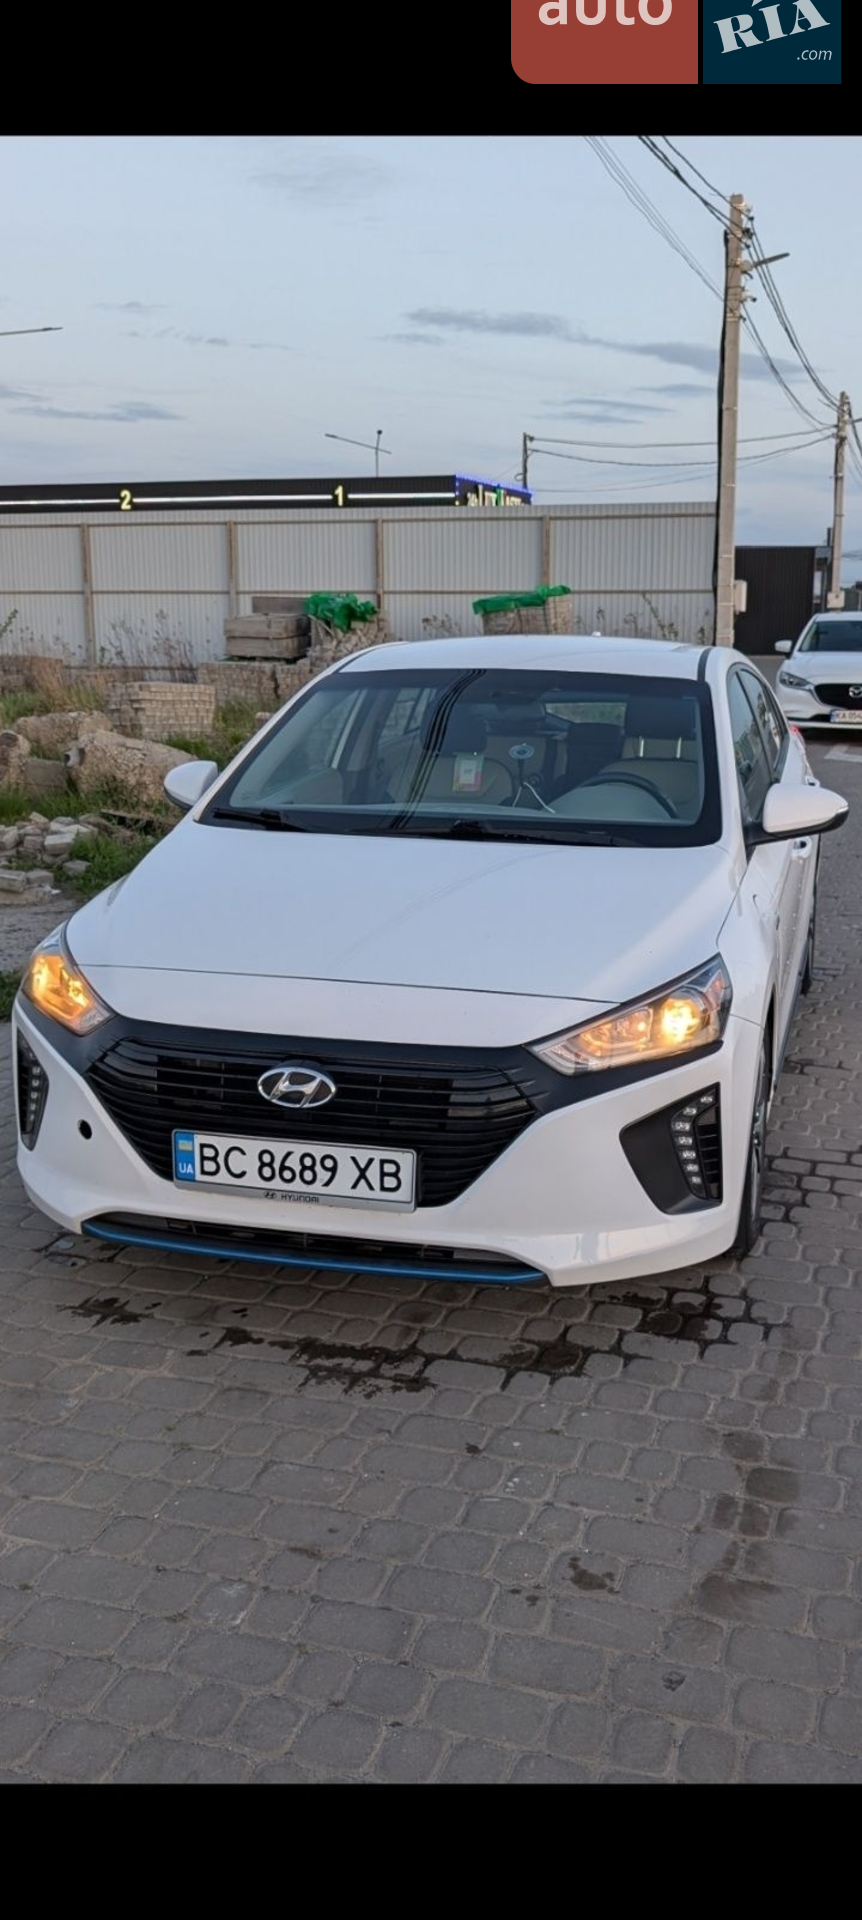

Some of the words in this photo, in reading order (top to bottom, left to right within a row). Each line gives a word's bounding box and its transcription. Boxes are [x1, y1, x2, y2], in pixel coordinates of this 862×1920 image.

[120, 489, 132, 510] 2
[334, 485, 343, 506] 1
[178, 1162, 194, 1174] UA
[198, 1143, 247, 1179] BC
[257, 1149, 339, 1187] 8689
[350, 1156, 402, 1193] XB
[280, 1193, 320, 1204] HYUNDAI
